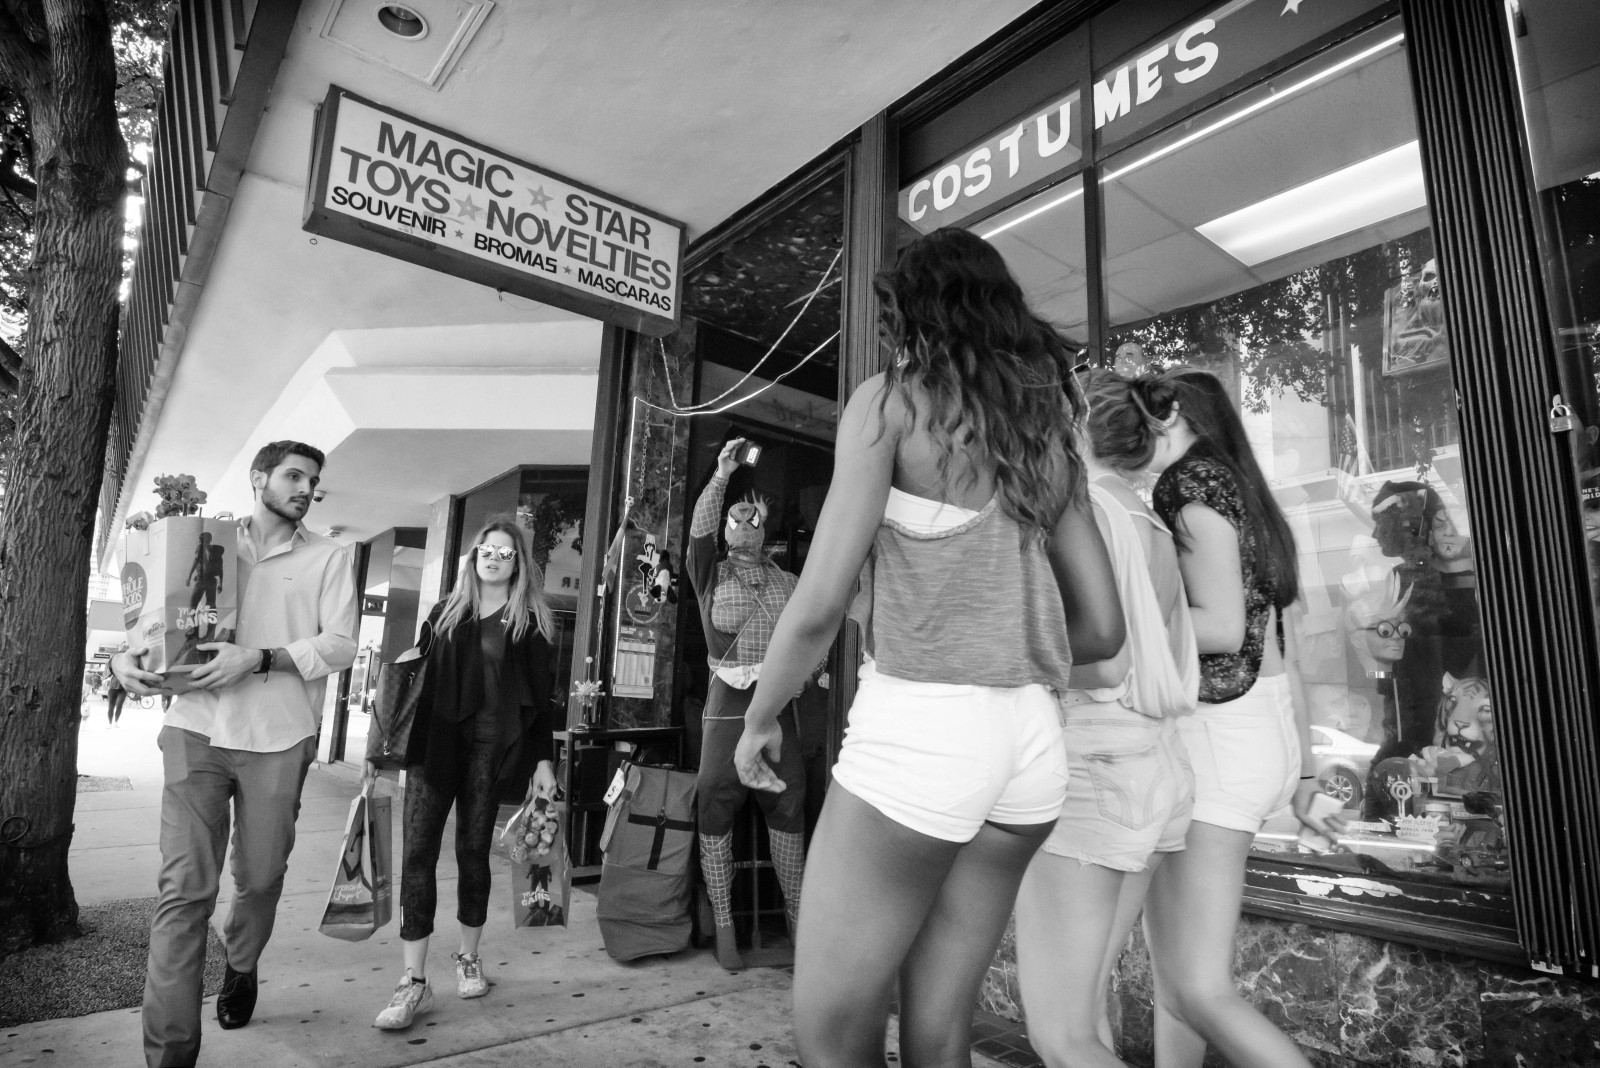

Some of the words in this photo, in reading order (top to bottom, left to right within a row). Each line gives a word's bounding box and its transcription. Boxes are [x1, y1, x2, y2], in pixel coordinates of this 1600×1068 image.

[909, 18, 1219, 222] COSTUMES
[331, 186, 447, 238] SOUVENIR
[474, 233, 557, 274] BROMAS
[577, 268, 672, 312] MASCARAS
[340, 146, 451, 214] TOYS
[486, 199, 672, 290] NOVELTIES
[377, 121, 515, 198] MAGIC
[564, 193, 652, 250] STAR
[176, 612, 218, 630] GAINS
[521, 893, 551, 907] GAINS
